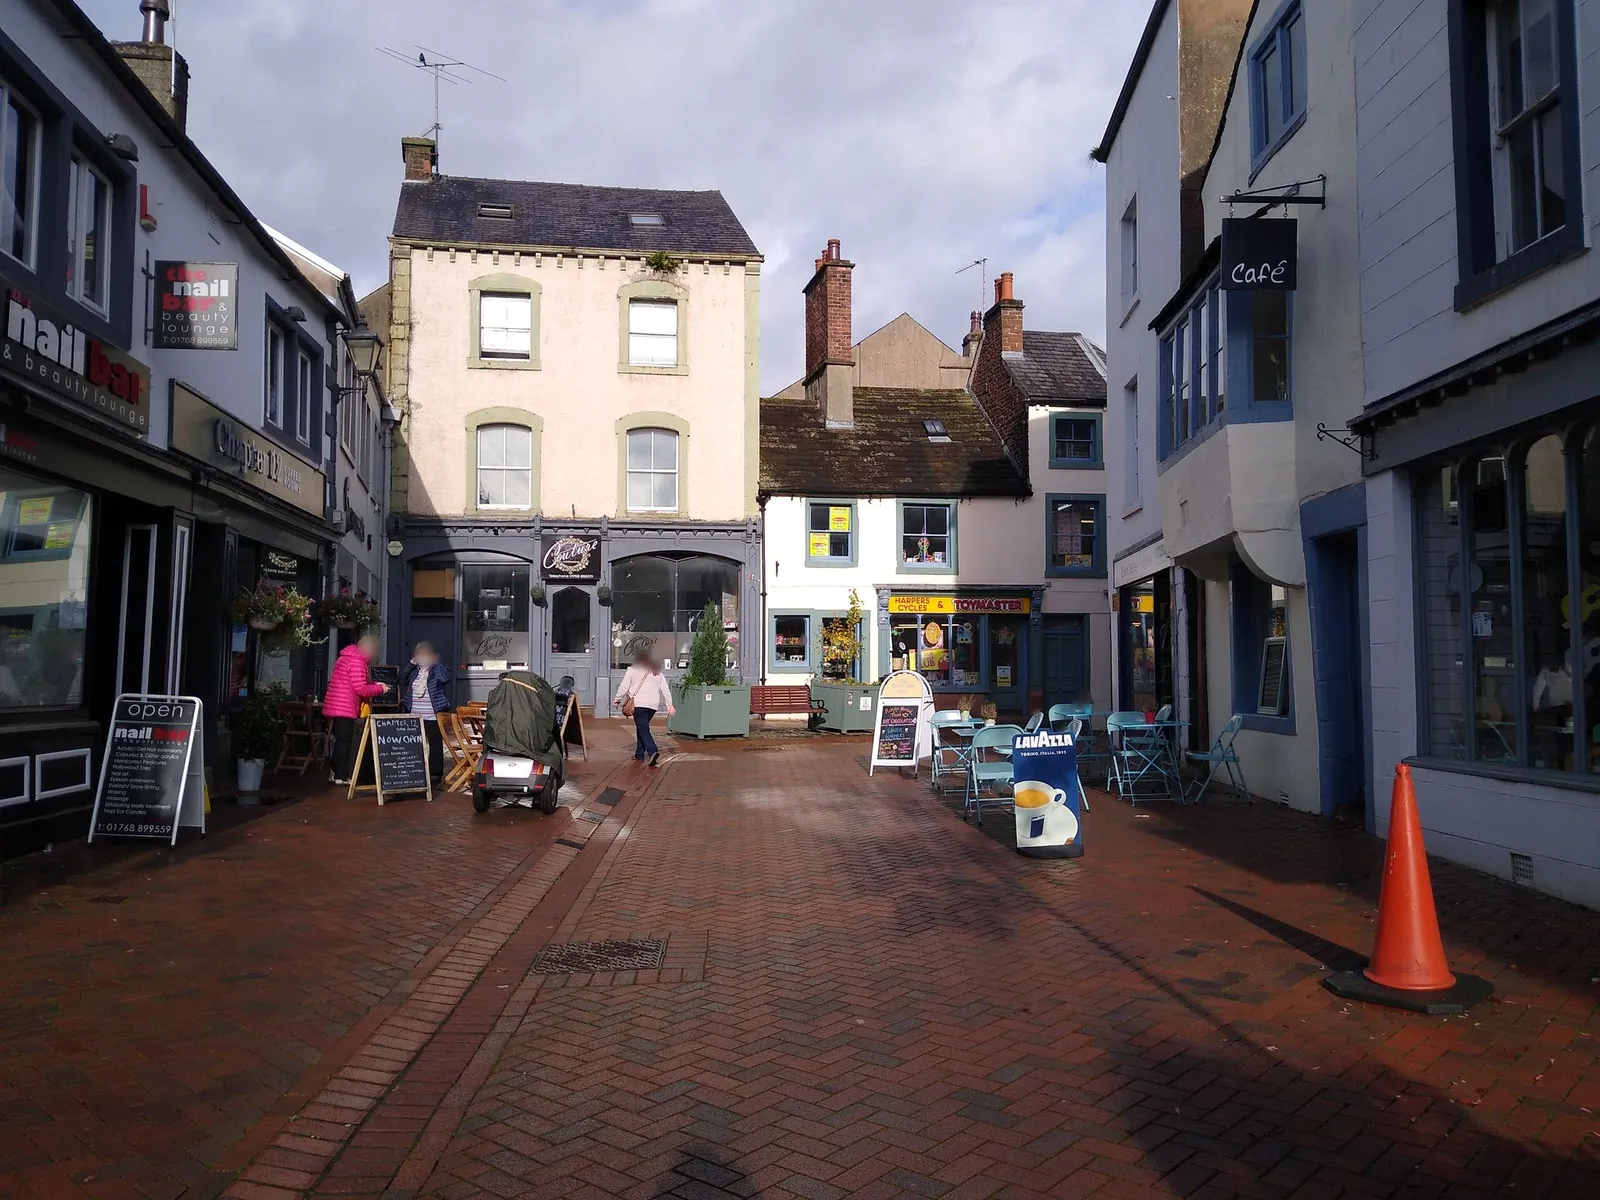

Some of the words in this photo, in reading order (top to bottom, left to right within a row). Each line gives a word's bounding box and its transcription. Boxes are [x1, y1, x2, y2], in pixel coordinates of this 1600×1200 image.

[166, 266, 207, 281] the
[1231, 260, 1287, 283] Café
[173, 279, 229, 296] nail
[162, 293, 216, 311] bar
[219, 302, 227, 311] &
[162, 311, 229, 323] beauty
[162, 322, 229, 335] lounge
[7, 299, 86, 376] nail
[88, 340, 143, 406] bar
[3, 344, 12, 360] &
[25, 353, 88, 399] beauty
[94, 389, 145, 426] lounge
[543, 539, 598, 569] Couture
[898, 604, 928, 612] CYCLES
[937, 601, 944, 609] &
[953, 598, 1023, 612] TOYMASTER
[128, 704, 183, 719] open
[411, 720, 419, 728] 12
[114, 726, 153, 739] nail
[378, 736, 401, 744] NOW
[402, 735, 422, 743] OPEN
[1015, 730, 1074, 749] LAVAZZA
[106, 823, 135, 832] 01768
[137, 824, 171, 833] 899559
